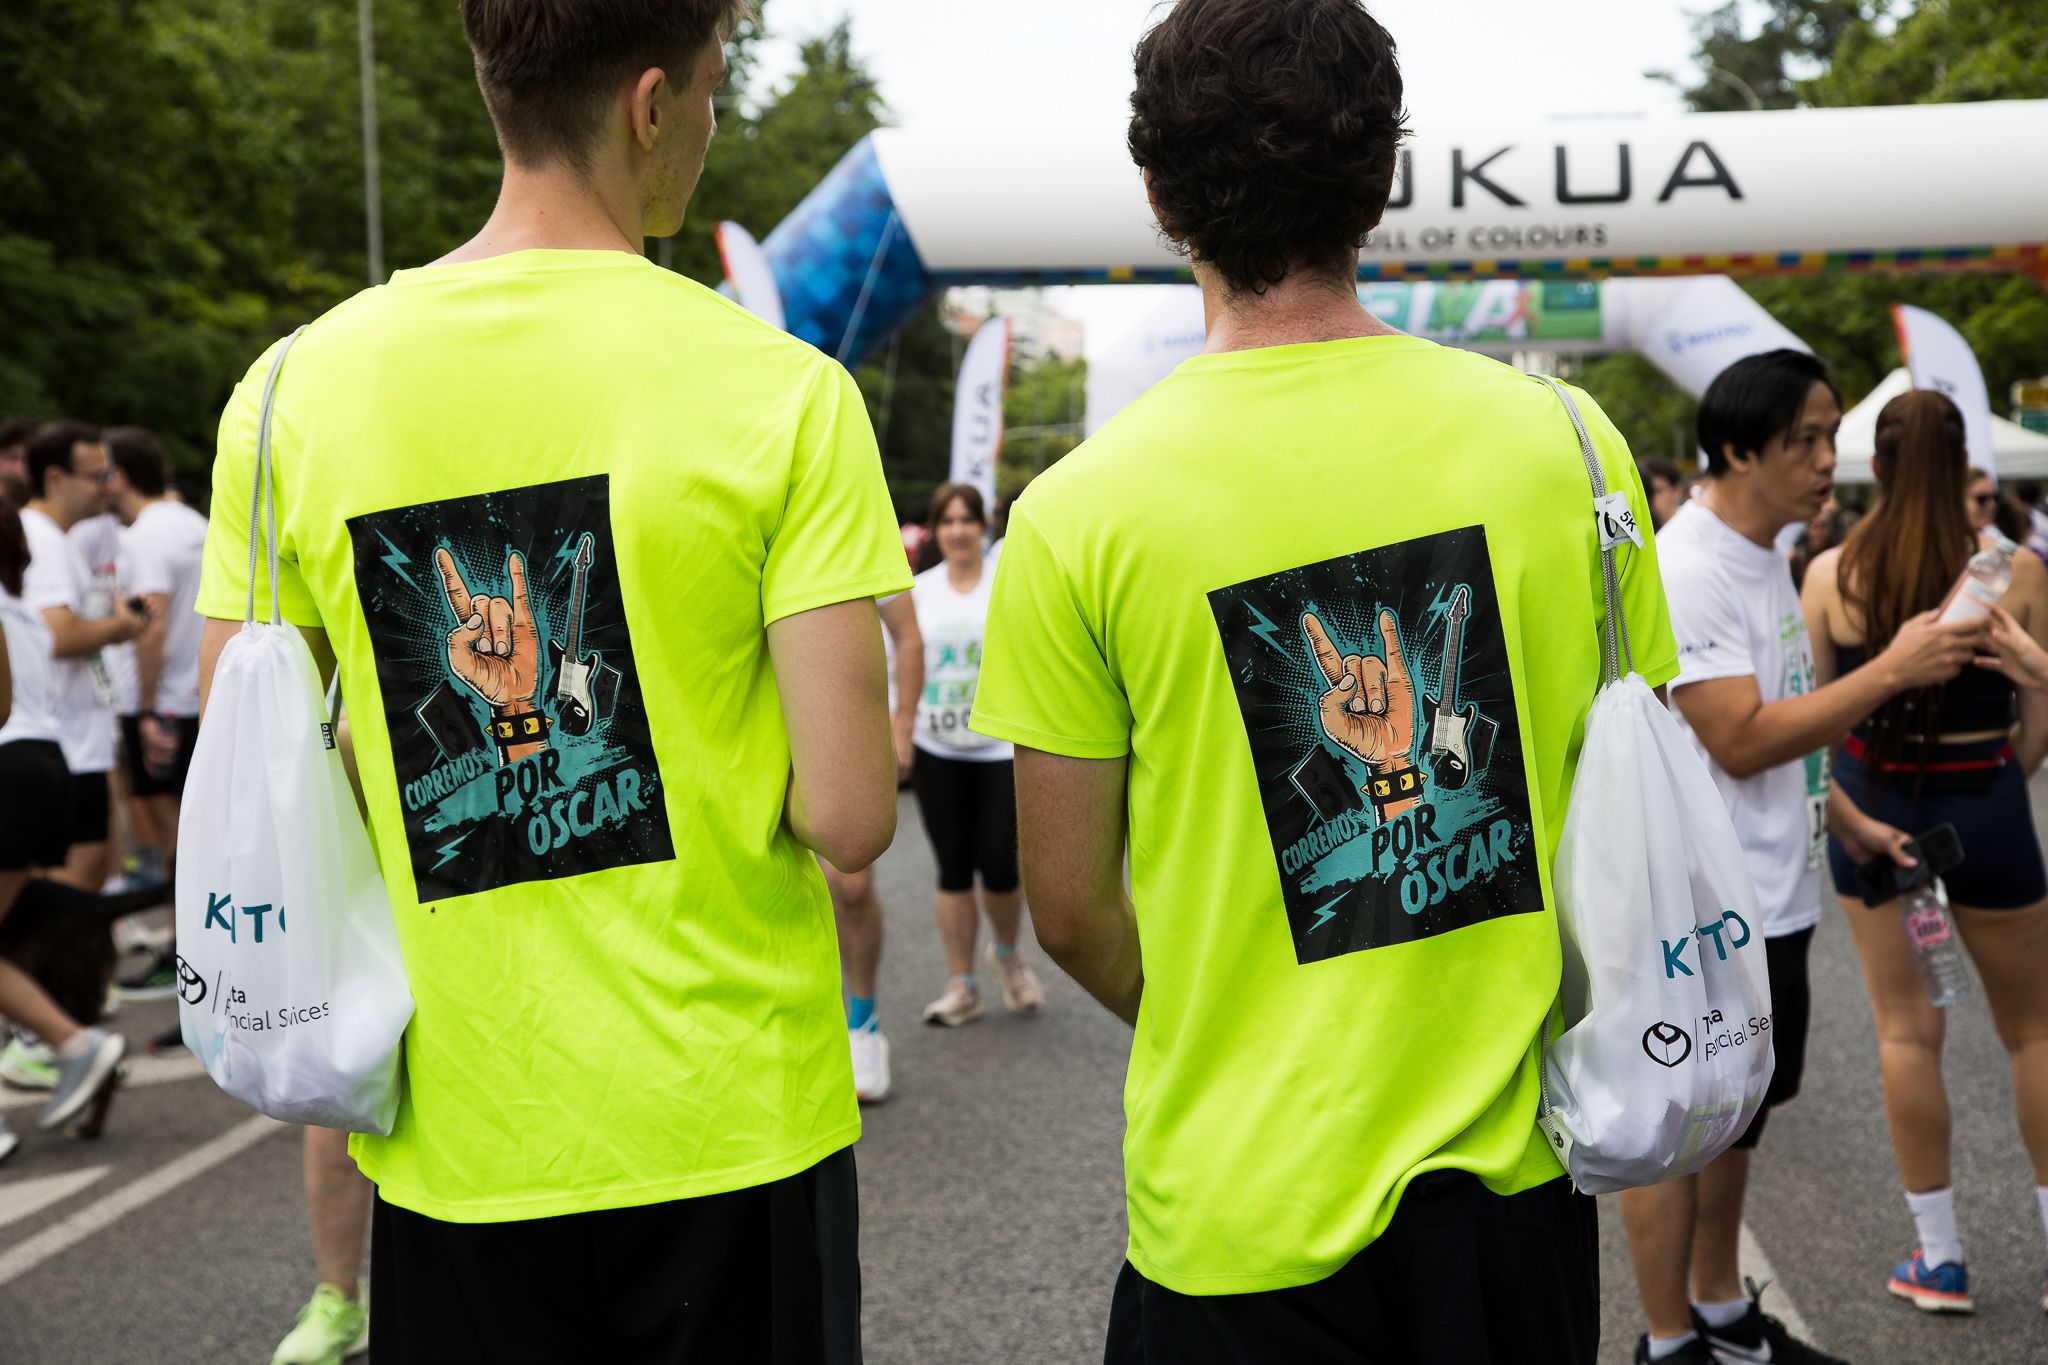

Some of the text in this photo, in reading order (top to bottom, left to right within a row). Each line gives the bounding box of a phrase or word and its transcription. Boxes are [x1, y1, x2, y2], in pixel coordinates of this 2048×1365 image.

[1418, 225, 1456, 250] OF
[1467, 222, 1608, 249] COLOURS
[1619, 510, 1637, 533] 5K
[405, 748, 484, 812] CORREMOS
[495, 747, 566, 814] POR
[1281, 807, 1360, 876] CORREMOS
[1370, 803, 1442, 873] POR
